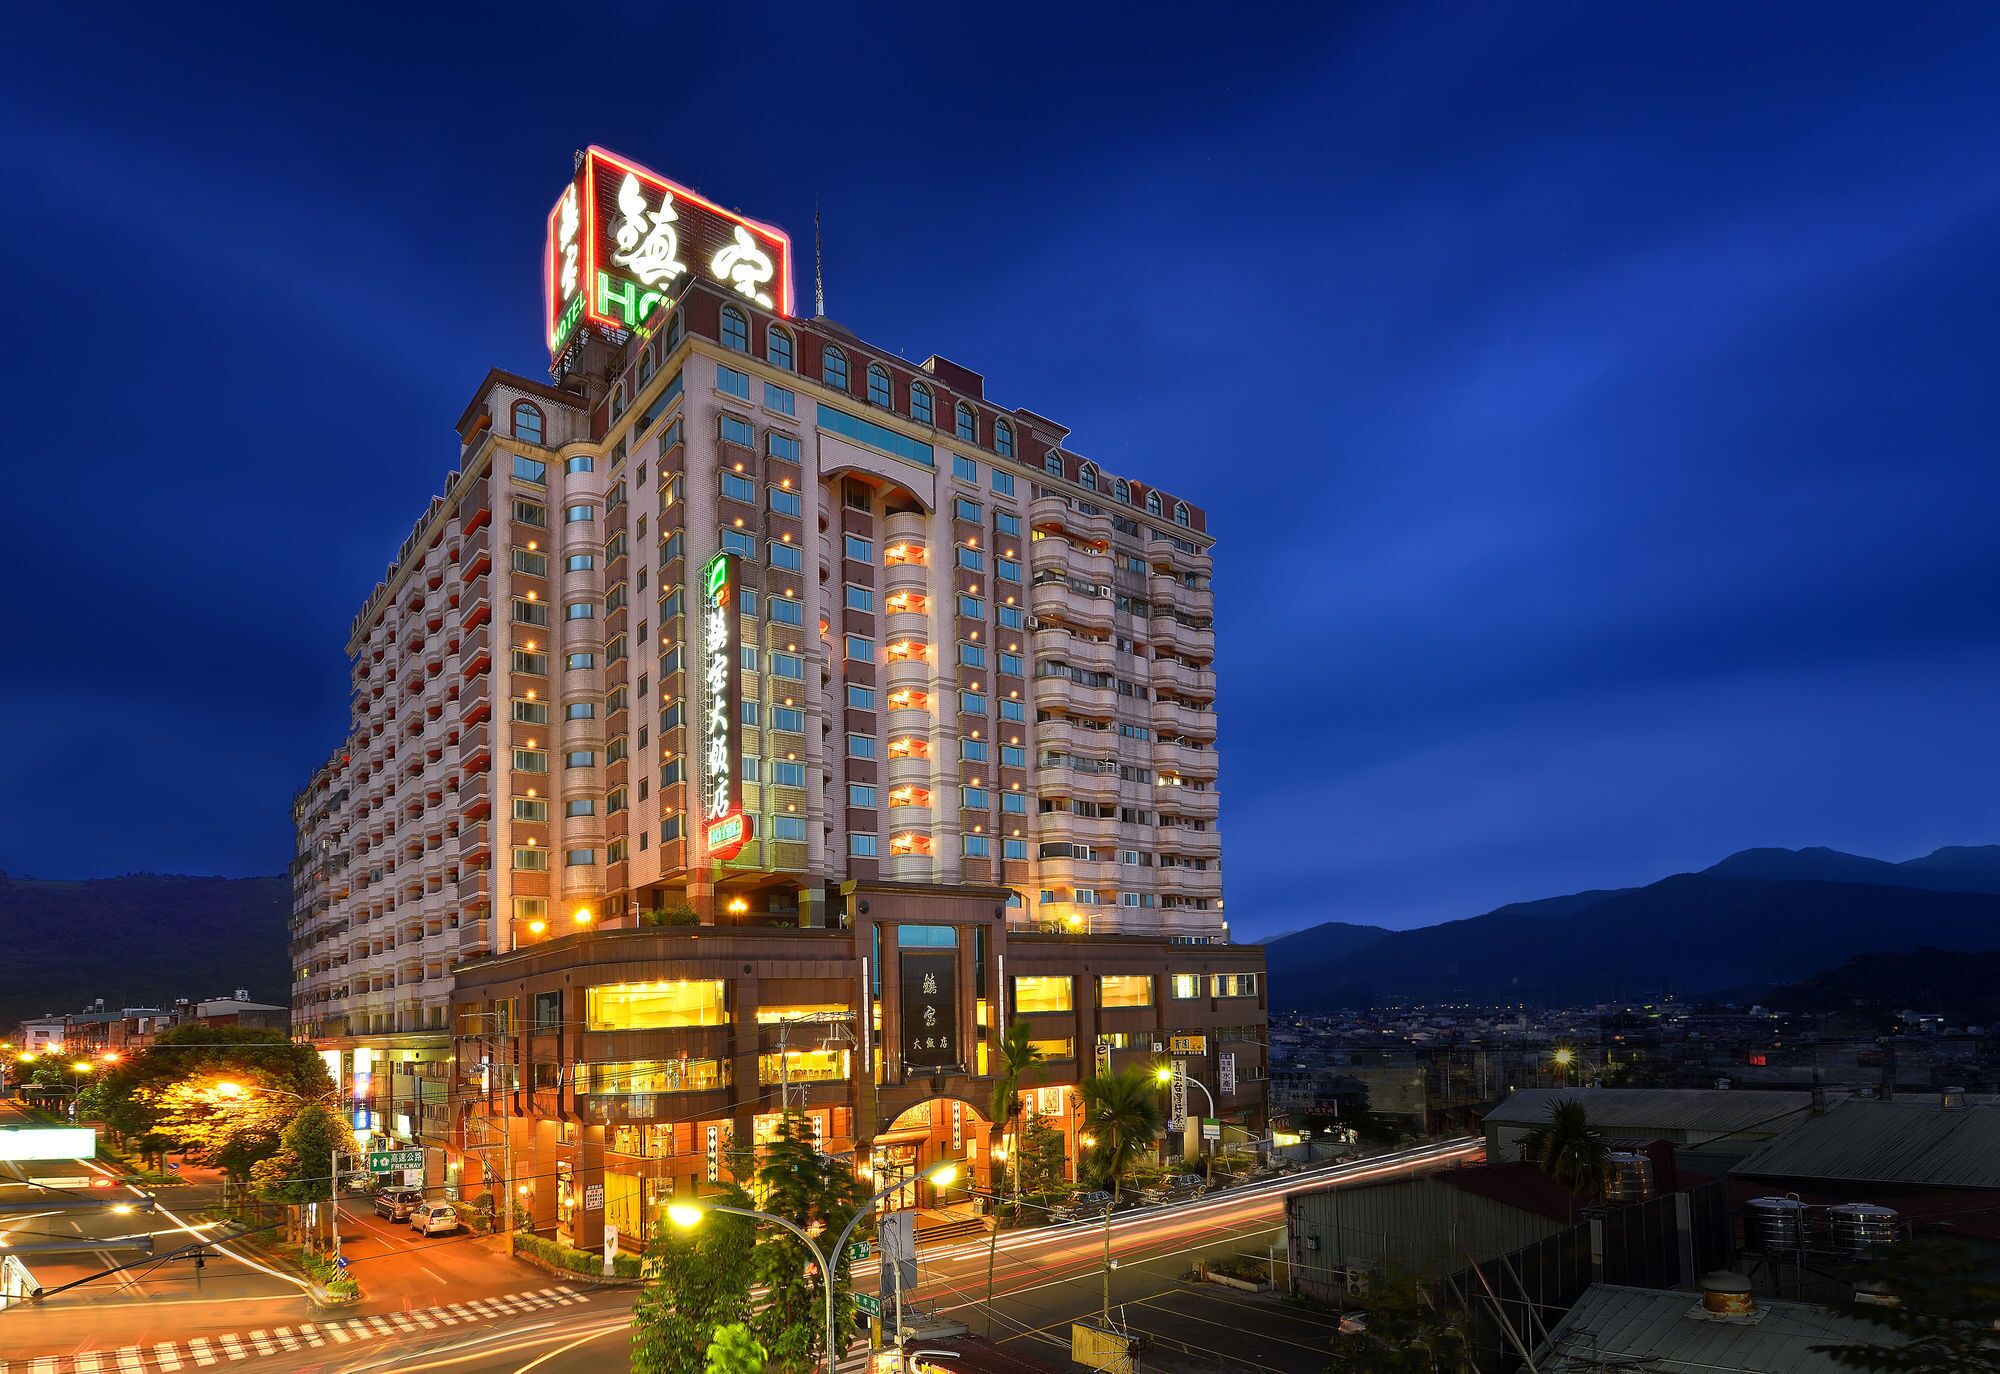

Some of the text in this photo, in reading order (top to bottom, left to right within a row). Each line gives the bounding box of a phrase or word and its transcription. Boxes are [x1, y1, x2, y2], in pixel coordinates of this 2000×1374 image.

[552, 290, 588, 351] HOTEL
[710, 821, 739, 845] HOTEL
[913, 1035, 948, 1050] 大飯店
[390, 1152, 422, 1163] 高速公路
[390, 1162, 422, 1170] FREEWAY
